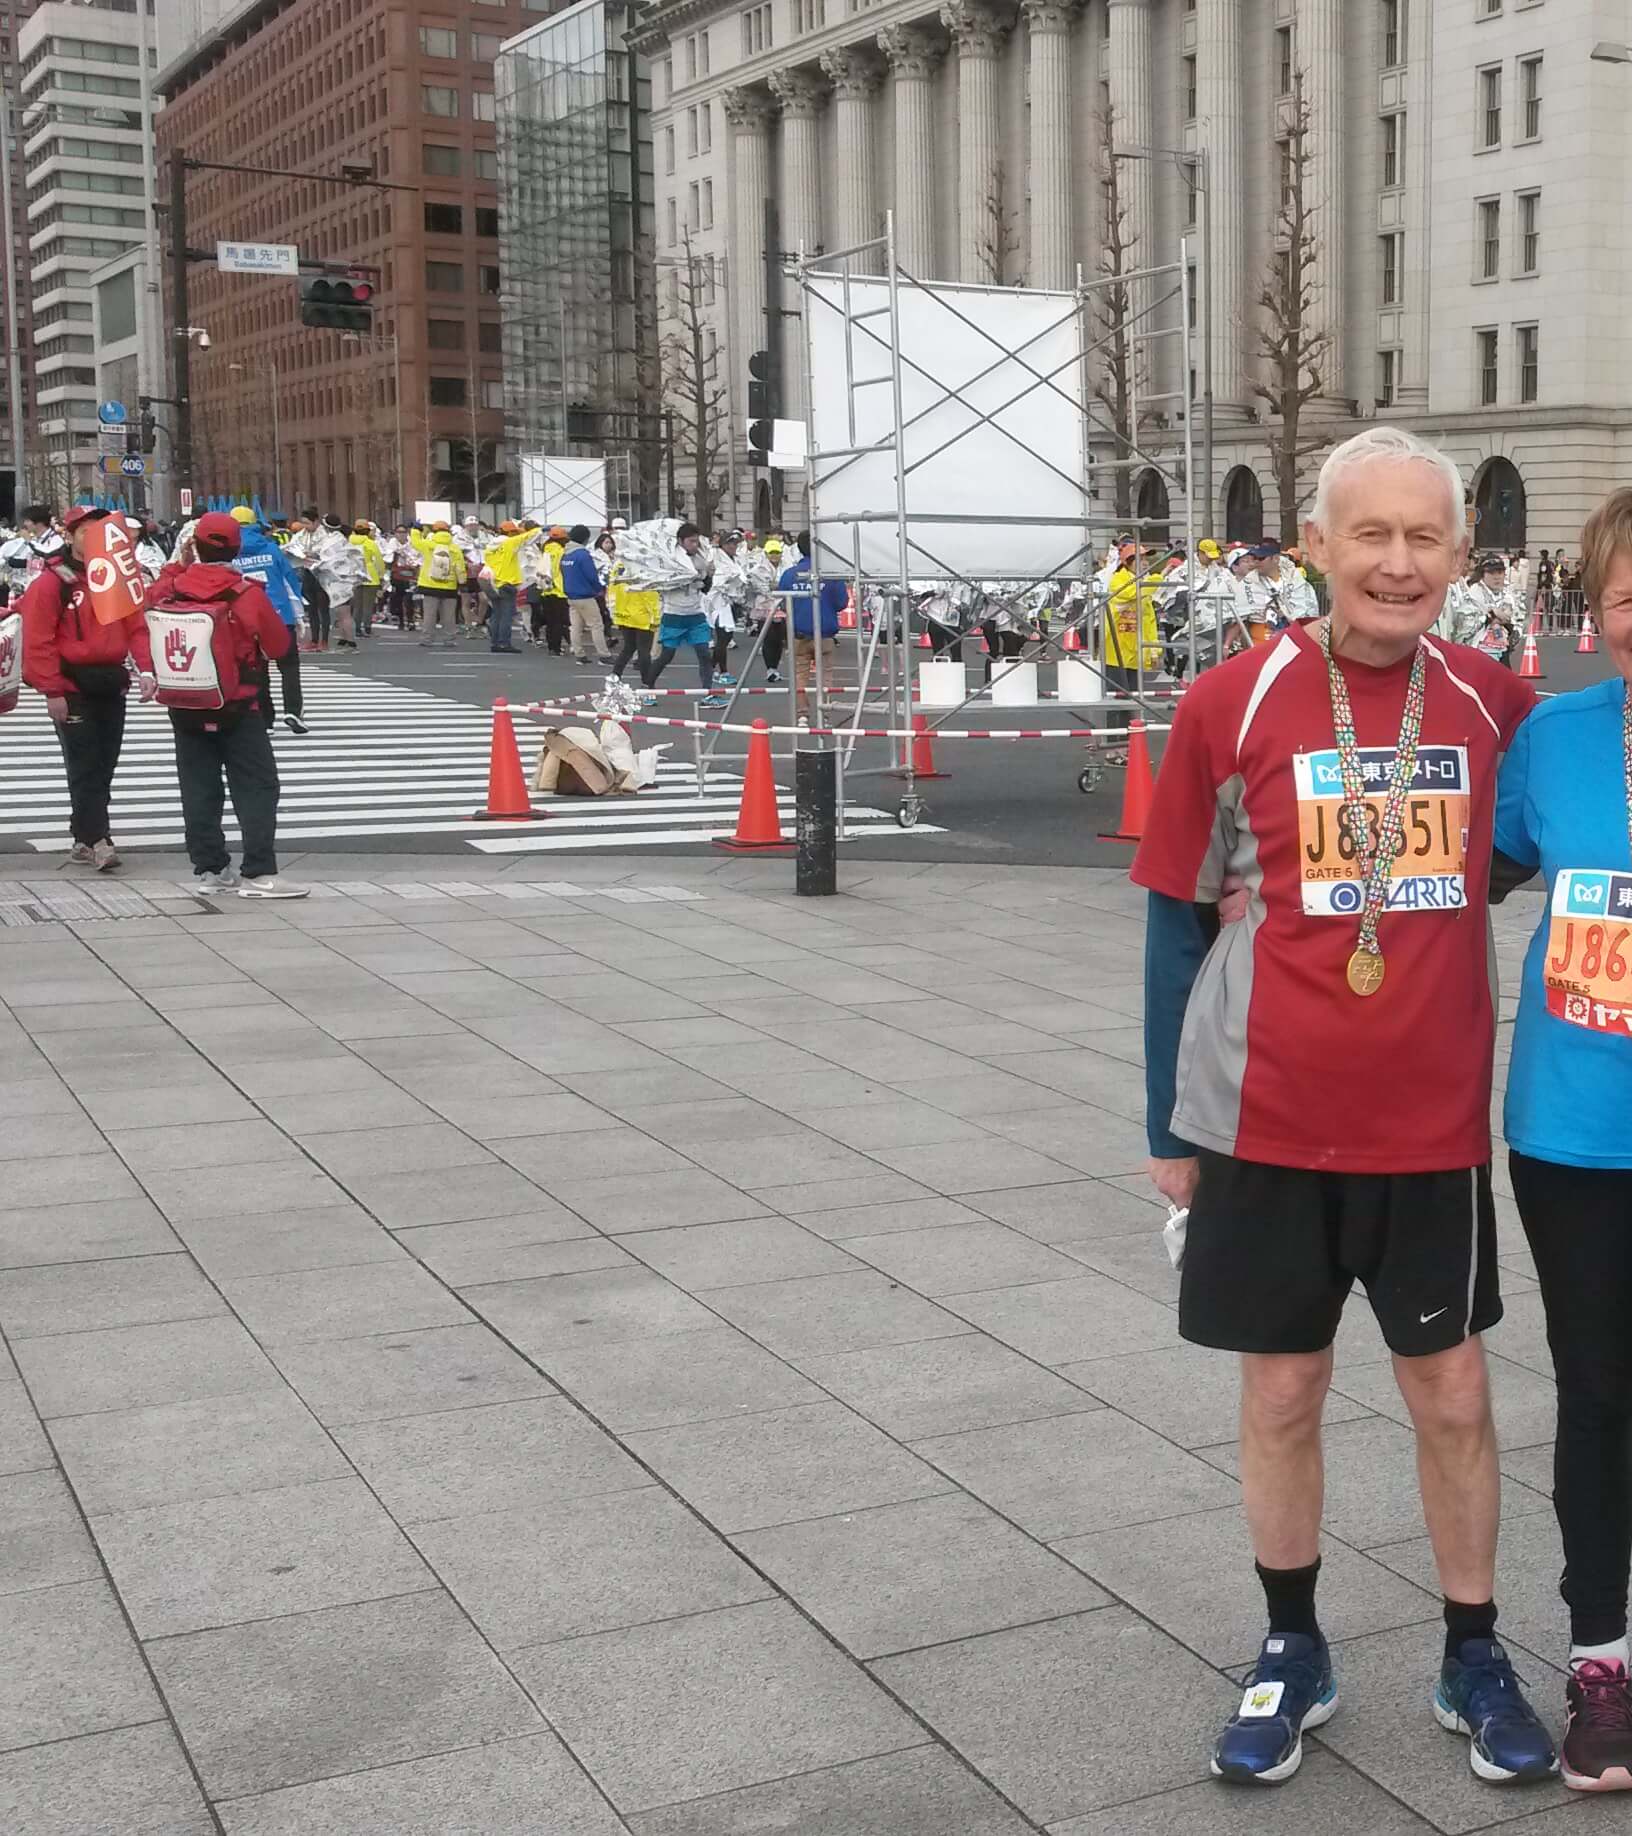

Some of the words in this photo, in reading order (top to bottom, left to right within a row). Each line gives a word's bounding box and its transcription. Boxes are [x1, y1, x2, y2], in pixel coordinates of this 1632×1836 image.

[122, 459, 142, 470] 406
[104, 522, 144, 605] AED
[1306, 868, 1342, 880] GATE
[1345, 867, 1353, 878] 5
[1548, 976, 1585, 992] GATE
